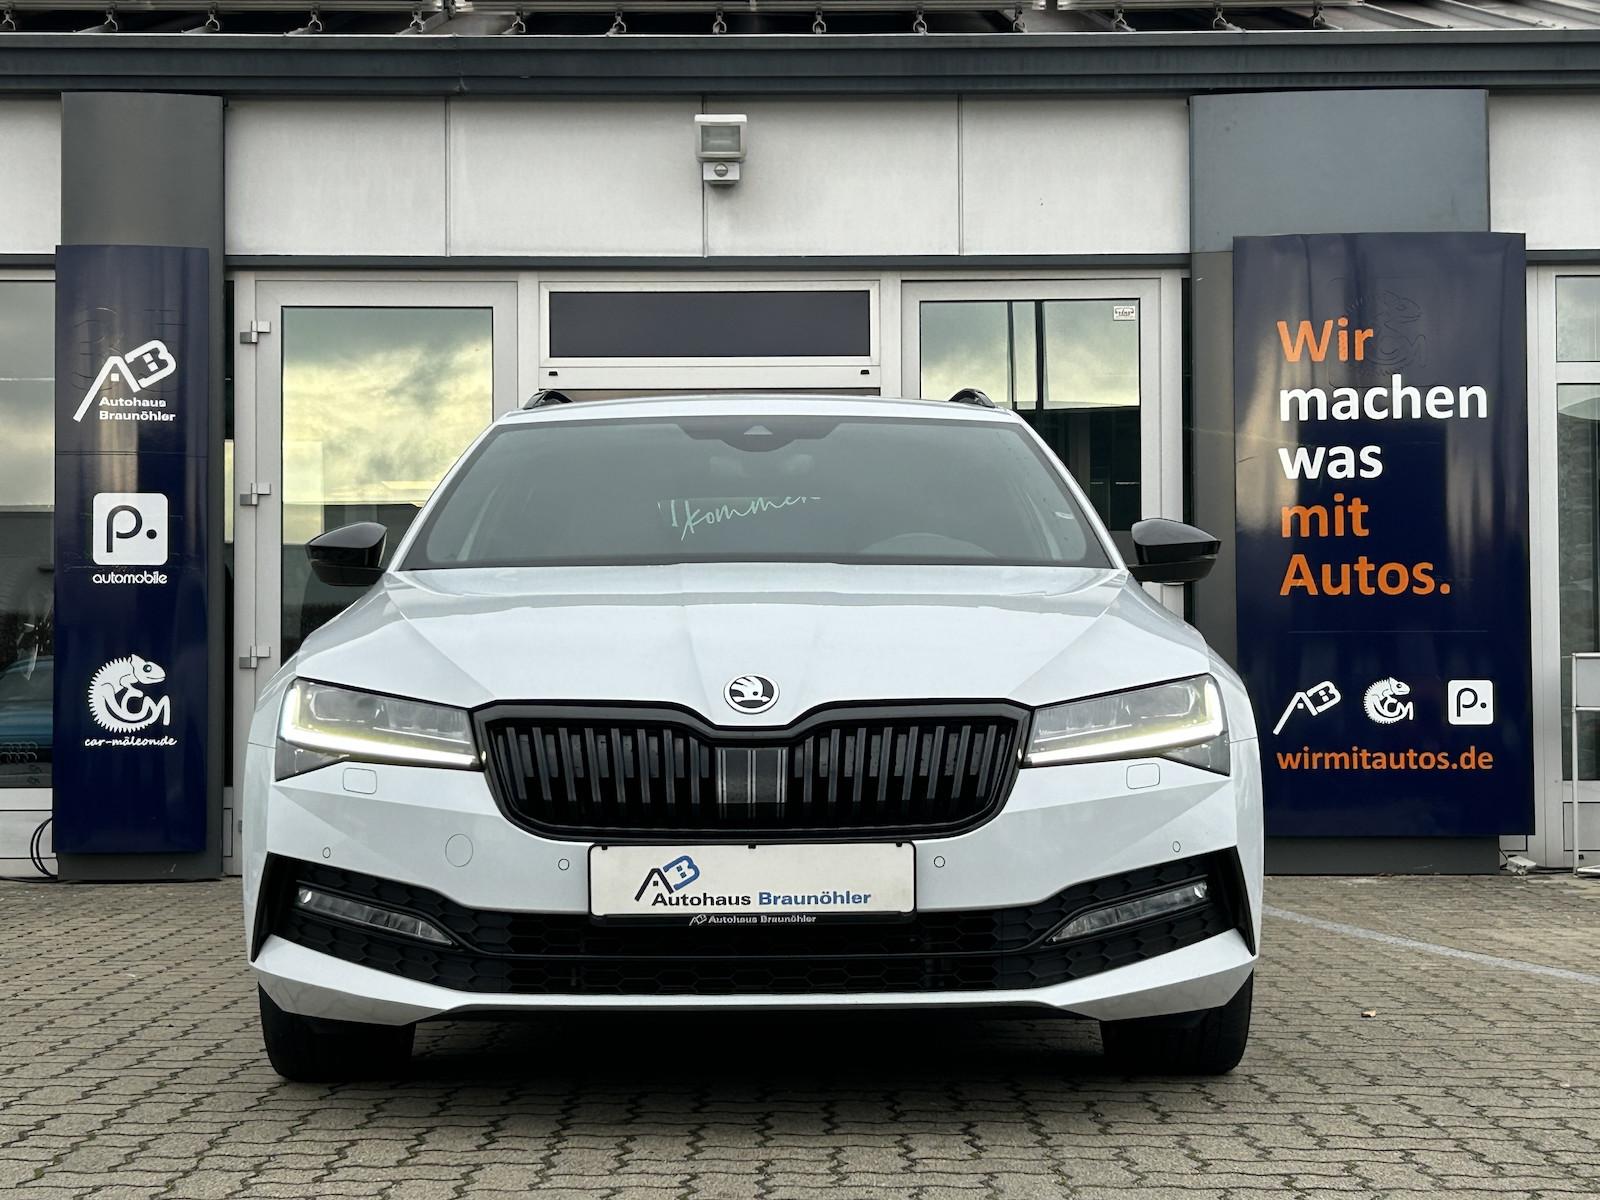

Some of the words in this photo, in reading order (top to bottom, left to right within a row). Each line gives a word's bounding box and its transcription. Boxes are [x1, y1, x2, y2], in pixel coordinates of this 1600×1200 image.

[1277, 317, 1374, 363] Wir
[99, 396, 167, 408] Autohaus
[1279, 373, 1488, 422] machen
[99, 409, 176, 422] Braunöhler
[1277, 445, 1383, 480] was
[1280, 493, 1369, 538] mit
[92, 570, 168, 585] automobile
[1279, 554, 1450, 596] Autos.
[1276, 746, 1493, 770] wirmitautos.de
[651, 892, 751, 906] Autohaus
[759, 890, 871, 906] Braunöhler
[708, 915, 757, 925] Autohaus
[760, 914, 817, 924] Braunöhler
